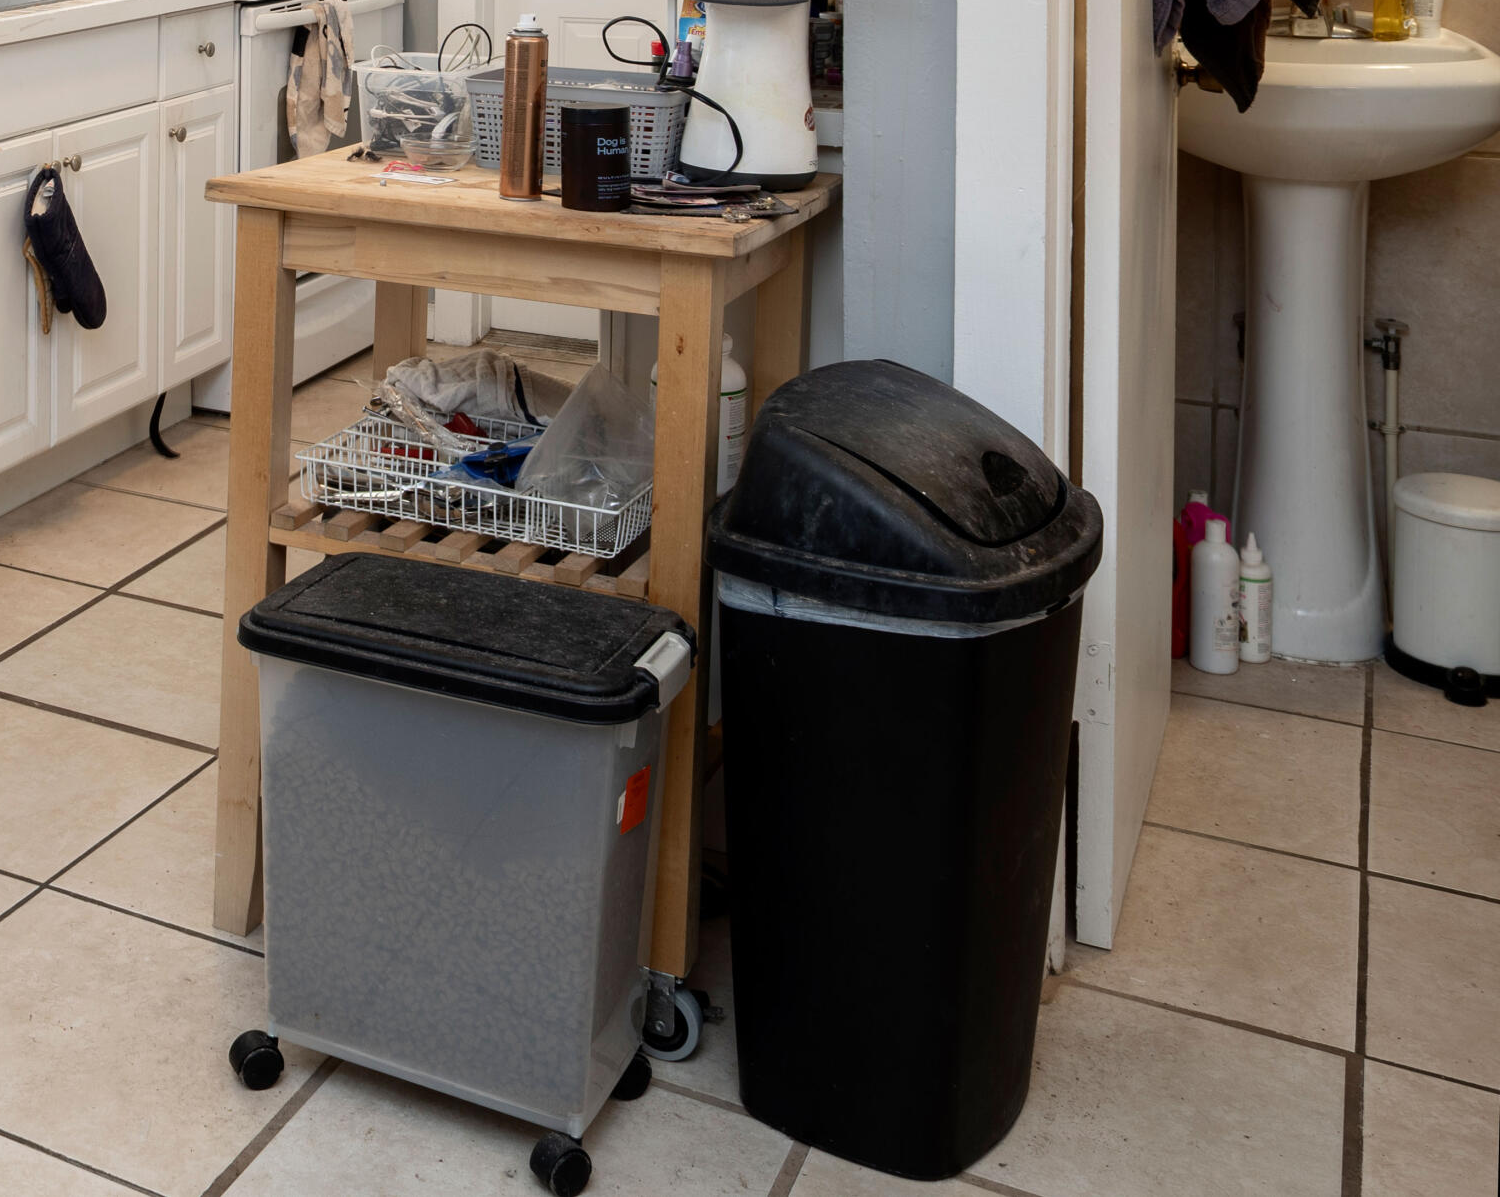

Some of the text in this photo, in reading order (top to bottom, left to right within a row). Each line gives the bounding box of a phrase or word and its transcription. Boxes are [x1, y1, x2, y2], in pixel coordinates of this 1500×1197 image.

[597, 136, 626, 147] Dog is
[597, 147, 630, 155] Human
